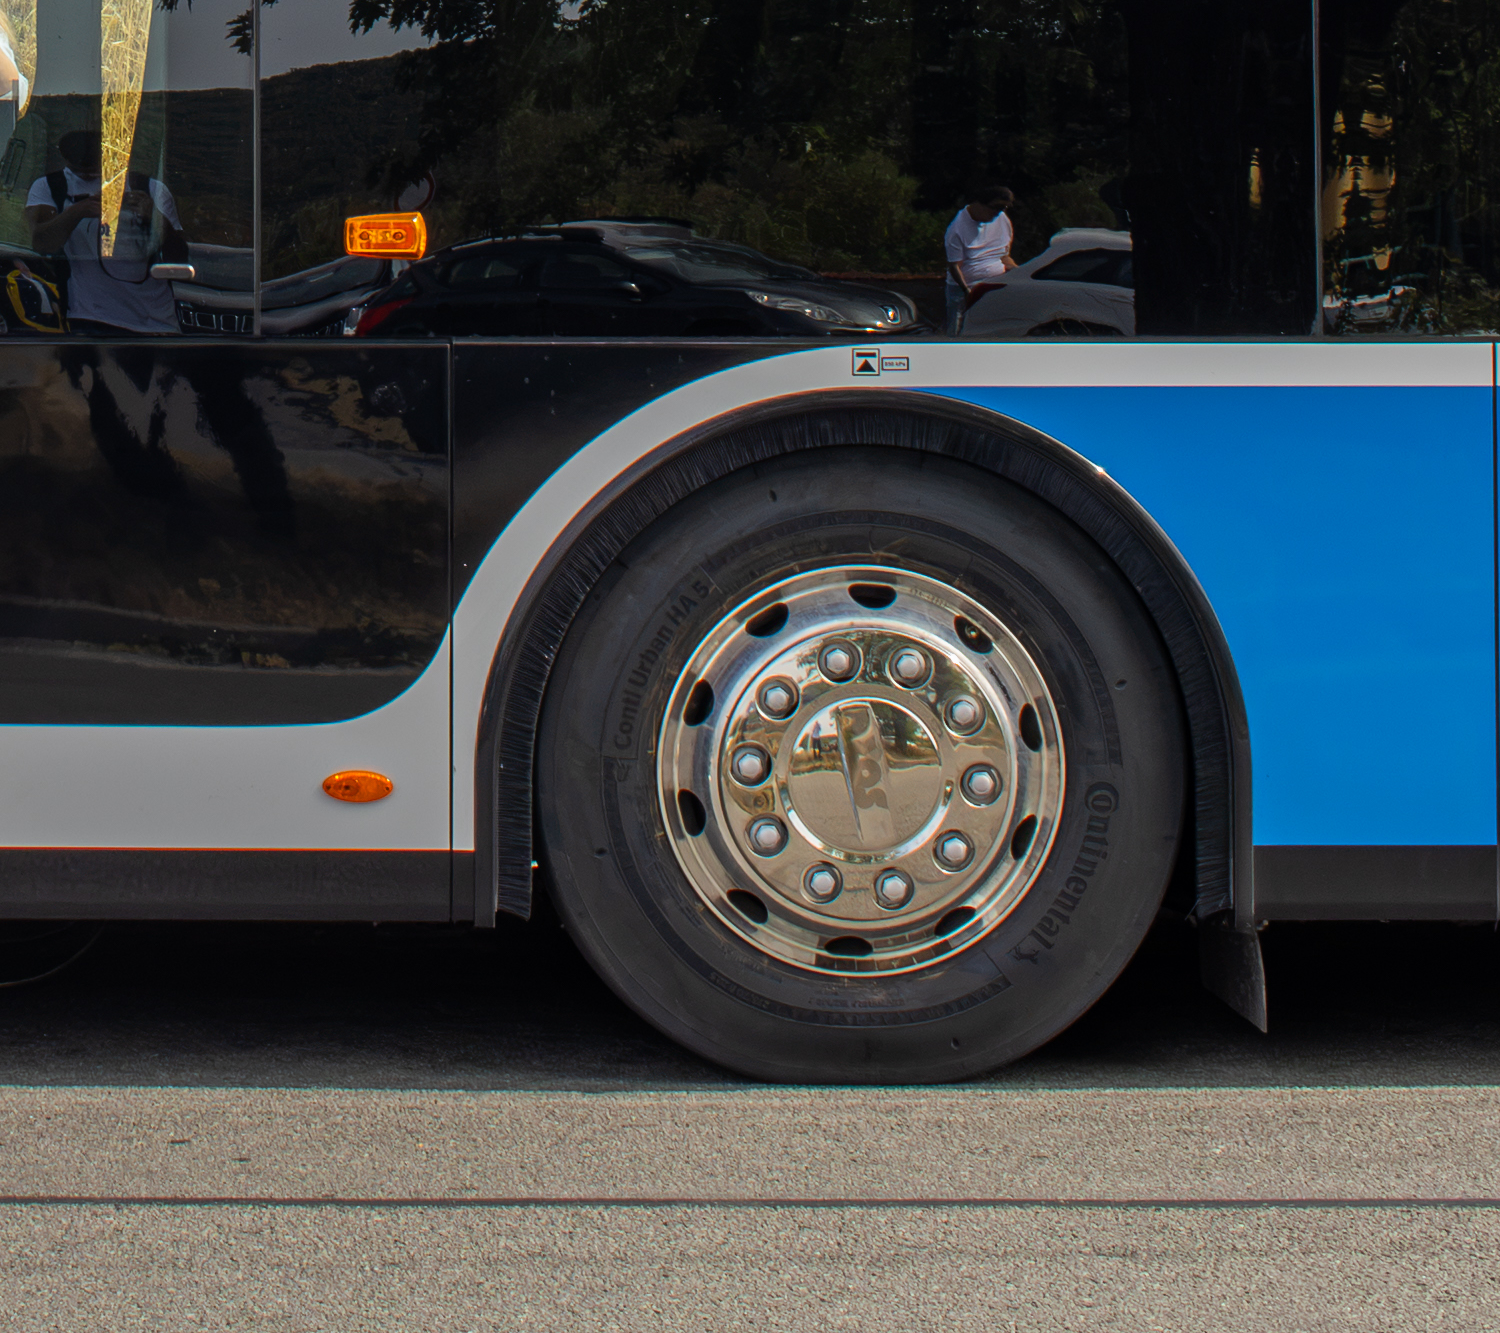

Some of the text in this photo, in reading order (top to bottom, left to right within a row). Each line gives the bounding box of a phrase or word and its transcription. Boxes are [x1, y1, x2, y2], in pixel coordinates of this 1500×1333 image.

[628, 624, 673, 684] Urban
[665, 594, 698, 627] HA
[692, 582, 710, 600] 5
[1030, 781, 1119, 950] Continental
